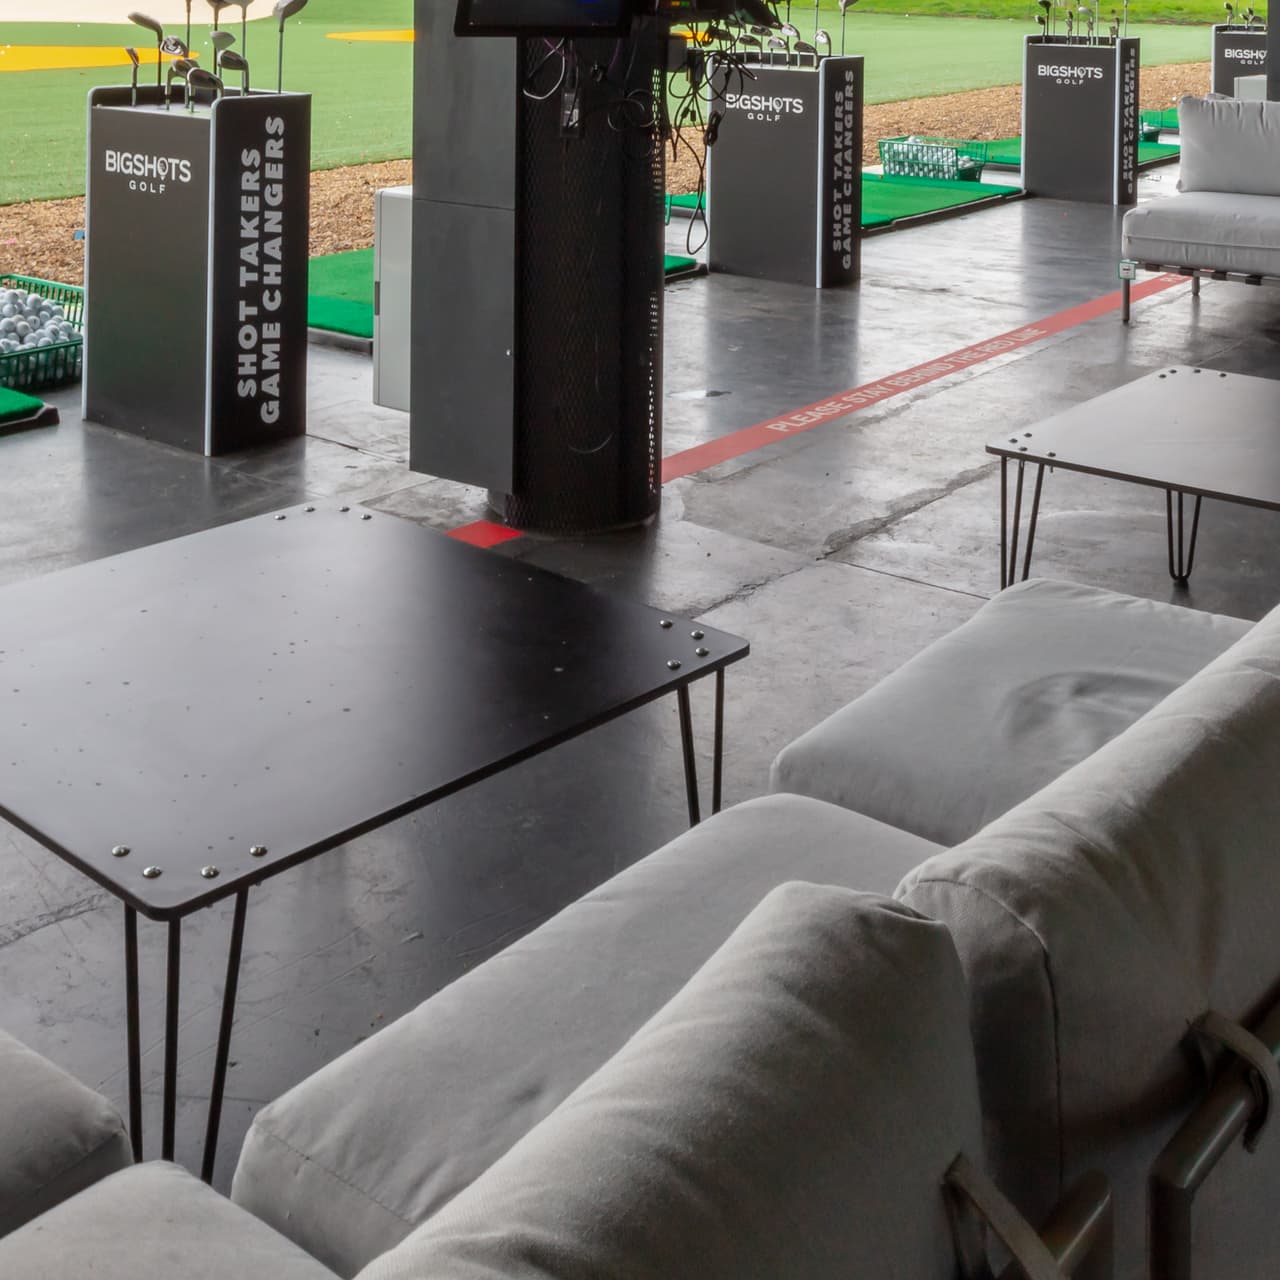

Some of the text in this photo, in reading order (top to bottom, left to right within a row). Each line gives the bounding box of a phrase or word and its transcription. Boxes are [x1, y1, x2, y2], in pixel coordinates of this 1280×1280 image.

[1224, 48, 1267, 60] BIGSHO
[1037, 64, 1104, 79] BIGSHOTS
[725, 93, 804, 114] BIGSHOTS
[747, 112, 781, 122] GOLF
[105, 150, 192, 183] BIGSHOTS
[832, 90, 844, 252] SHOT TAKERS
[842, 69, 854, 269] GAME CHANGERS
[129, 180, 166, 194] GOLF
[237, 148, 261, 398] SHOT TAKERS
[260, 116, 285, 424] GAME CHANGERS
[765, 402, 854, 432] PLEASE
[848, 384, 891, 404] STAY
[887, 363, 955, 387] BEHIND
[943, 350, 987, 364] THE
